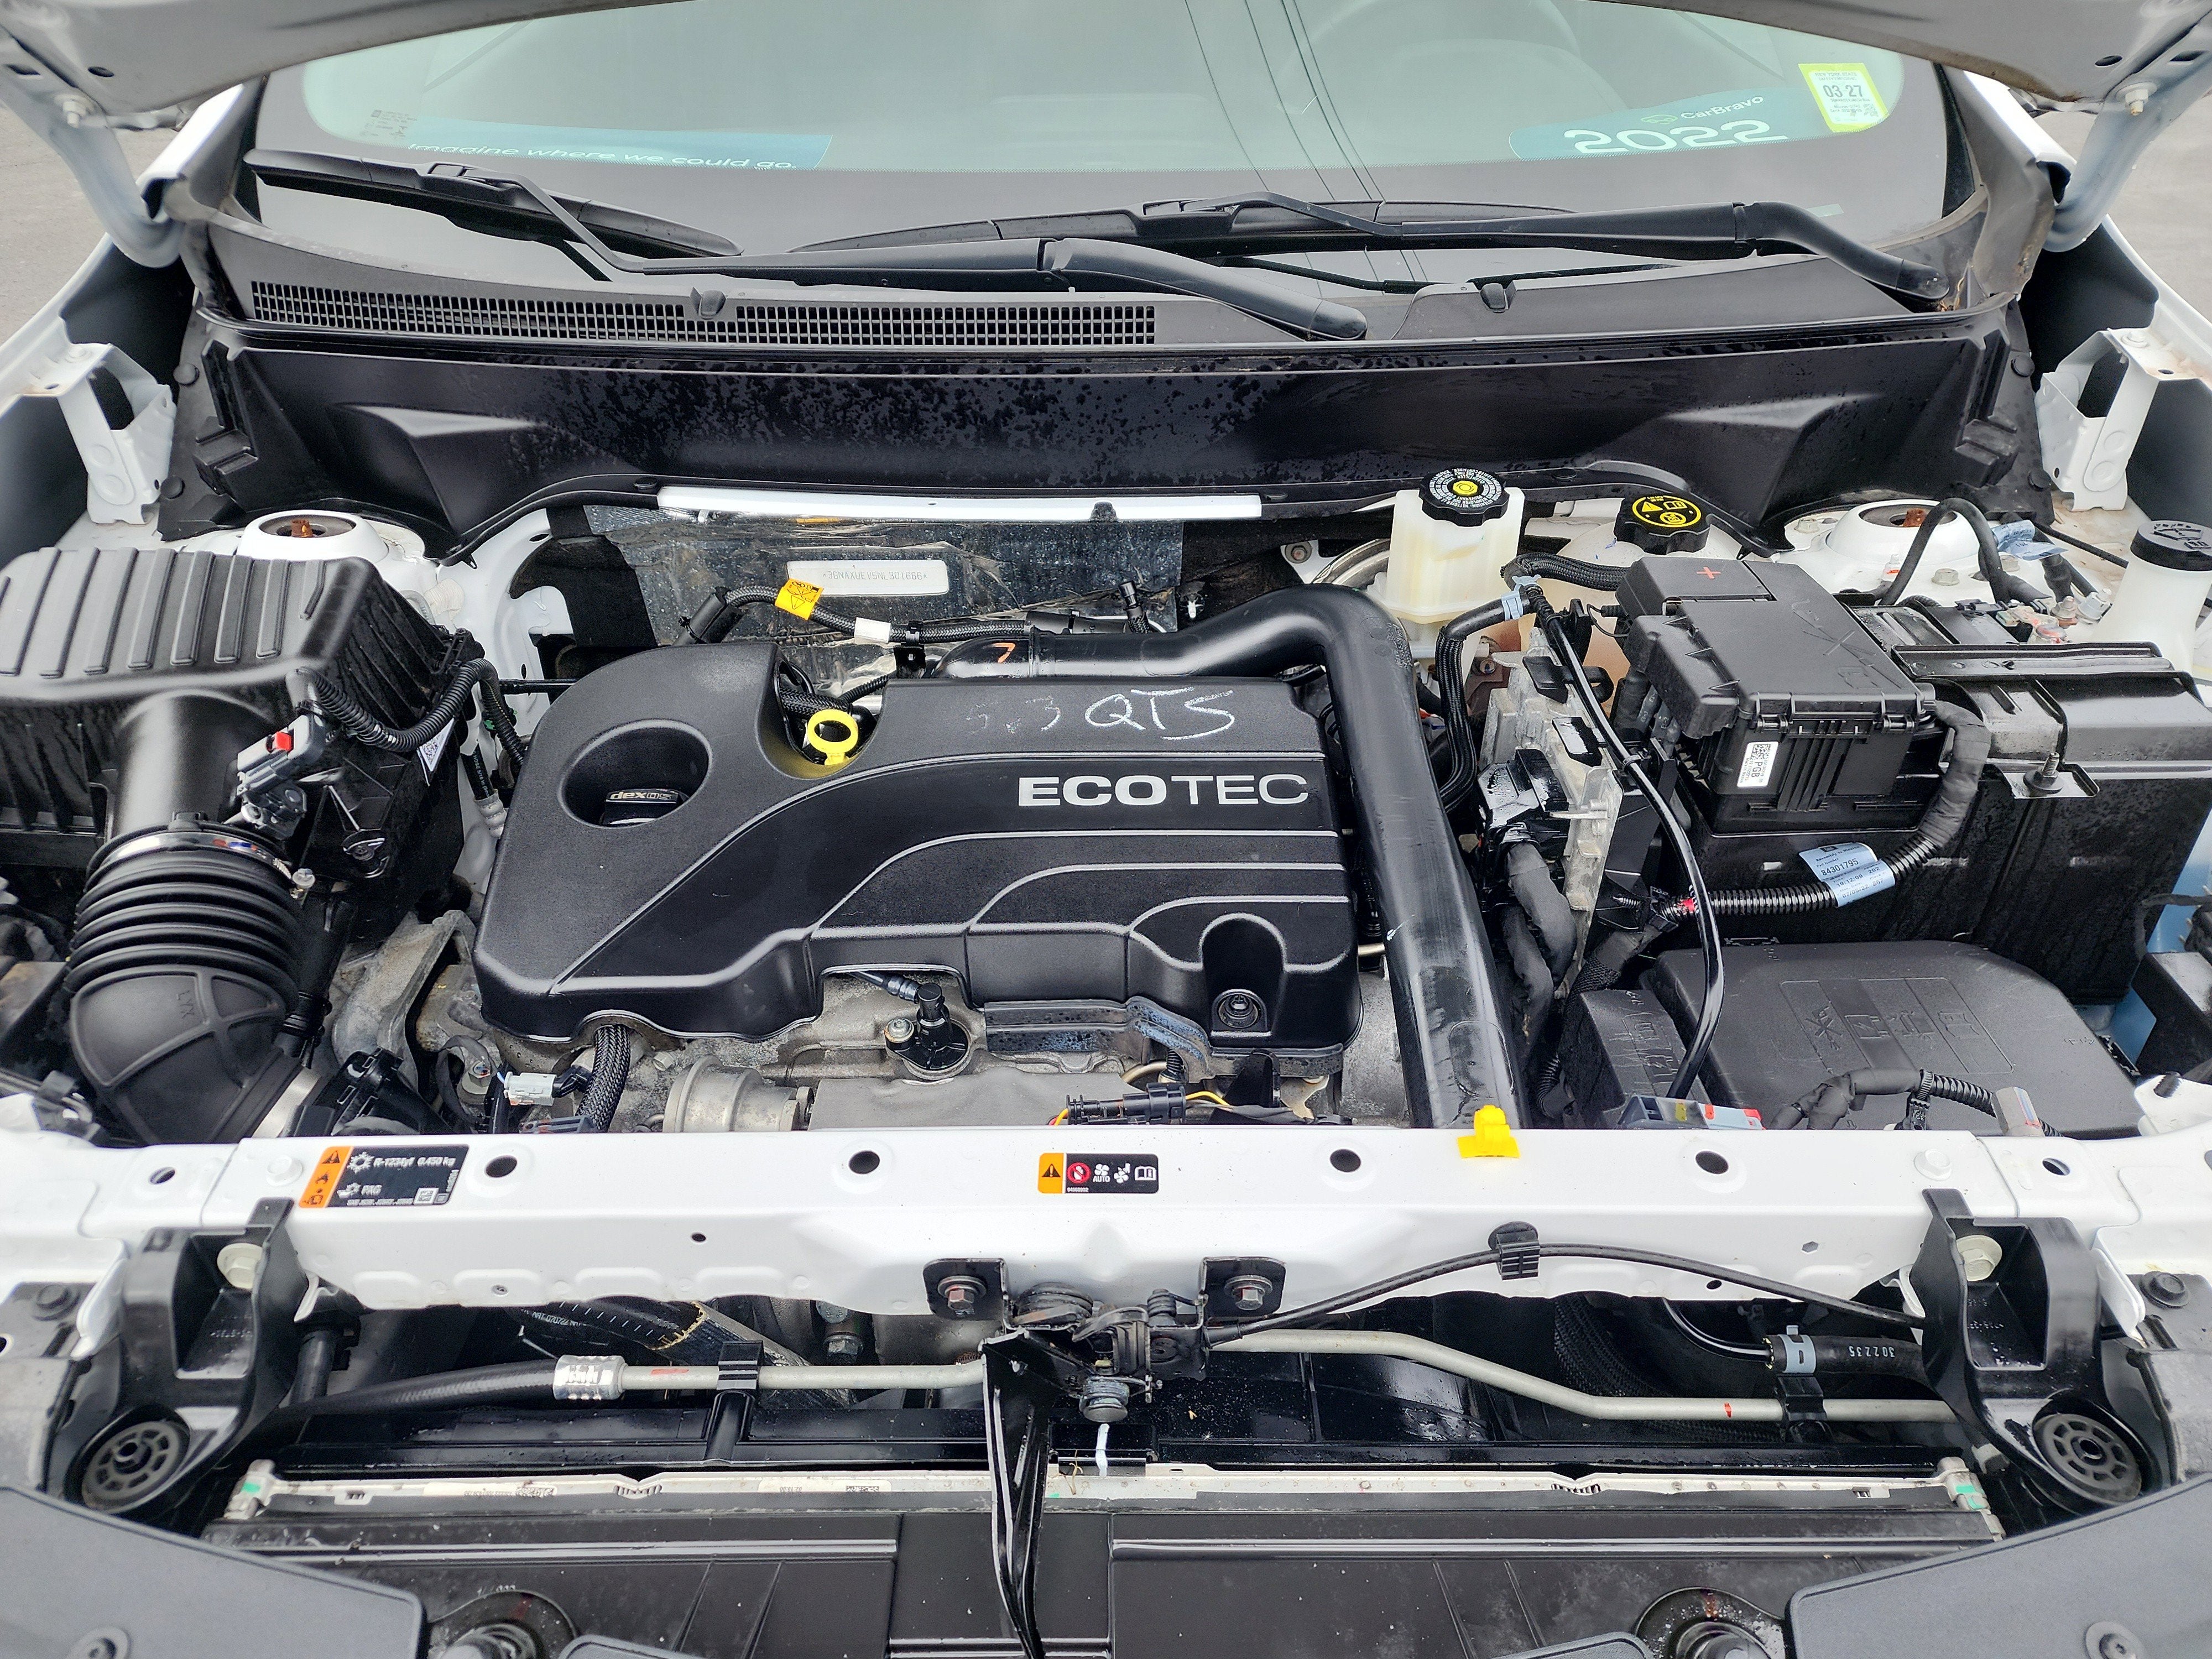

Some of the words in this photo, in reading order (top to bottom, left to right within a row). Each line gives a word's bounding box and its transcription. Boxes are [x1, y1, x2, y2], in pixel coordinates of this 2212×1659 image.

[1823, 85, 1863, 97] 03-27
[1680, 96, 1764, 119] CarBravo
[1564, 119, 1790, 154] 2022
[408, 143, 519, 154] Imagine
[528, 149, 615, 159] where
[671, 158, 750, 167] could
[1084, 687, 1235, 740] QTS
[1751, 761, 1763, 778] PGB
[610, 790, 672, 800] dexos
[1018, 774, 1308, 807] ECOTEC
[1821, 858, 1859, 876] 84301795
